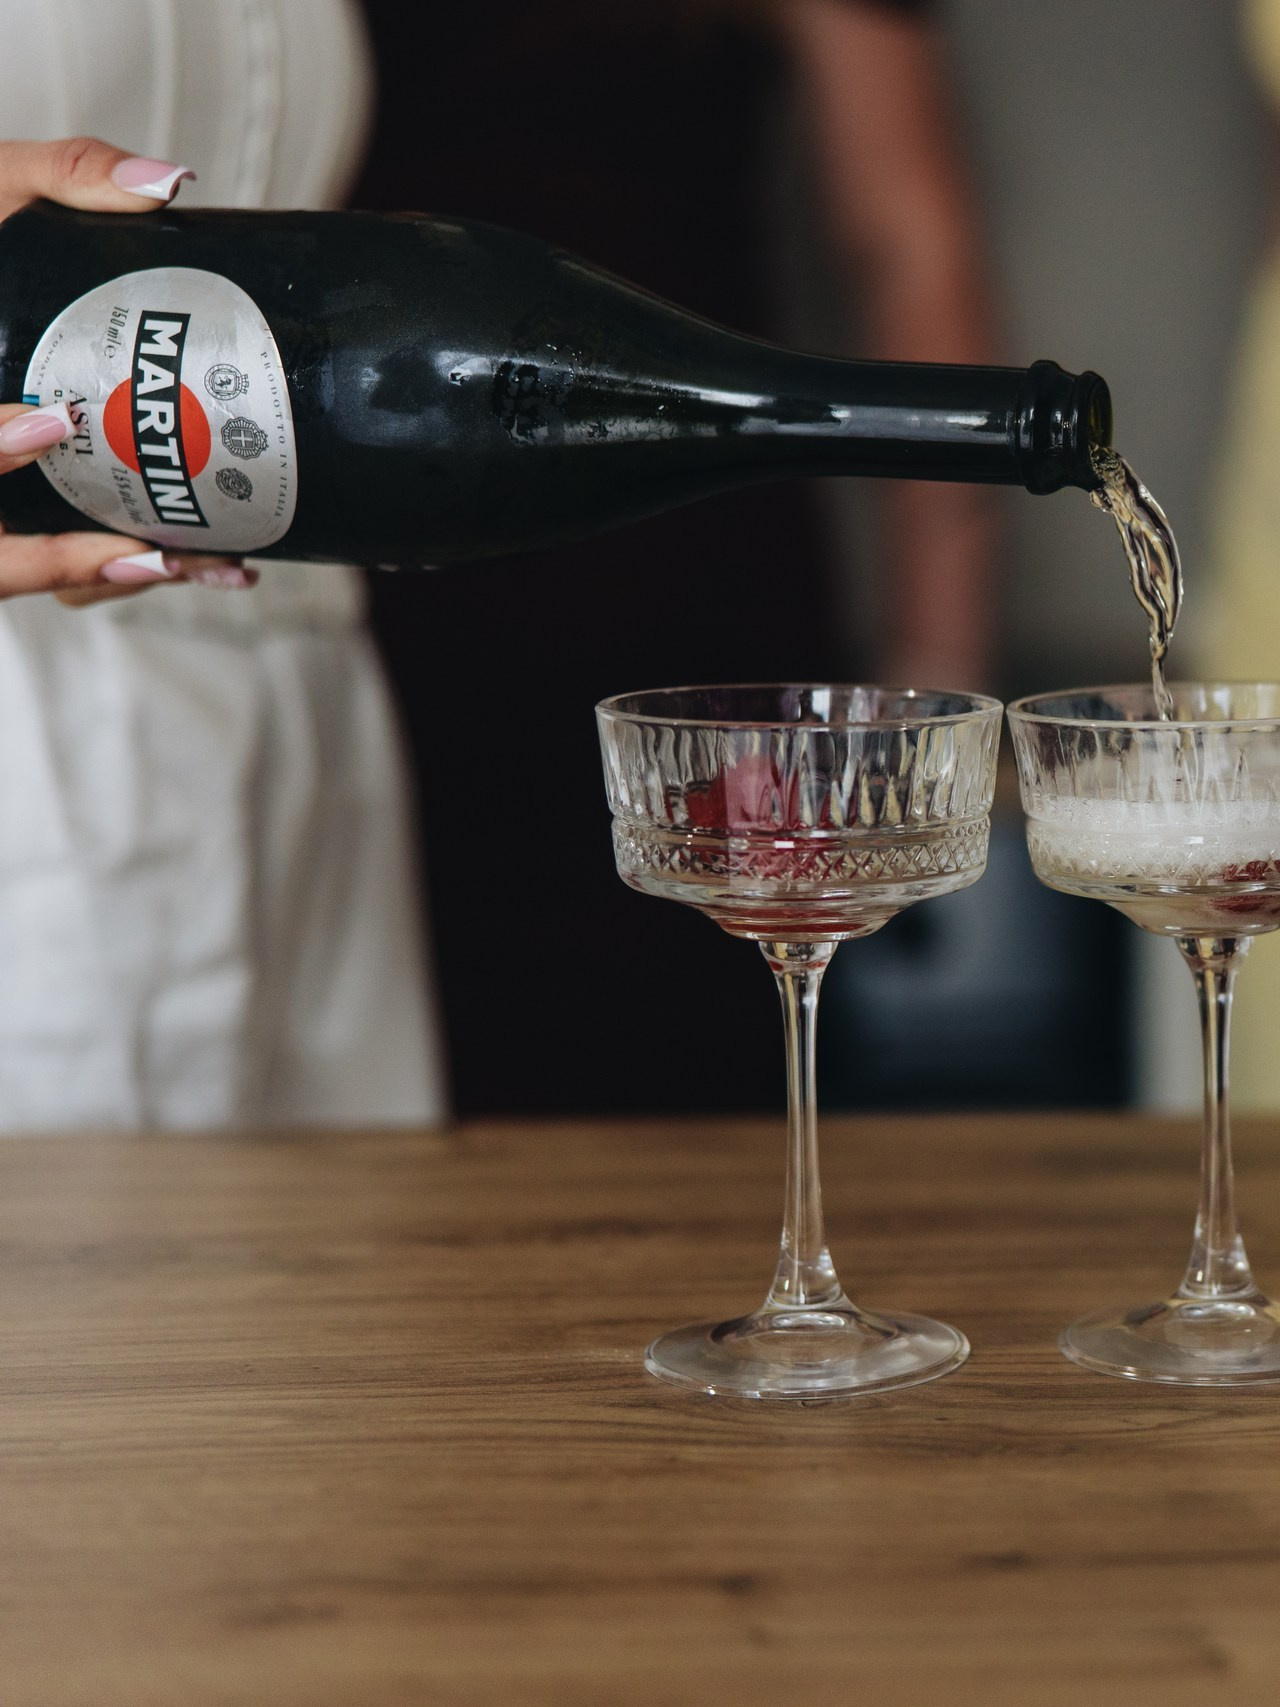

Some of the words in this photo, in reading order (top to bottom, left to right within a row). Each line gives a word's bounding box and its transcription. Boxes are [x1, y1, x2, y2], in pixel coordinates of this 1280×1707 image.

[106, 326, 122, 346] ml
[109, 306, 129, 328] 750
[260, 351, 286, 444] PRODOTTO
[69, 388, 94, 456] ASTI
[137, 318, 201, 523] MARTINI
[279, 453, 288, 469] IN
[274, 476, 288, 517] ITALIA
